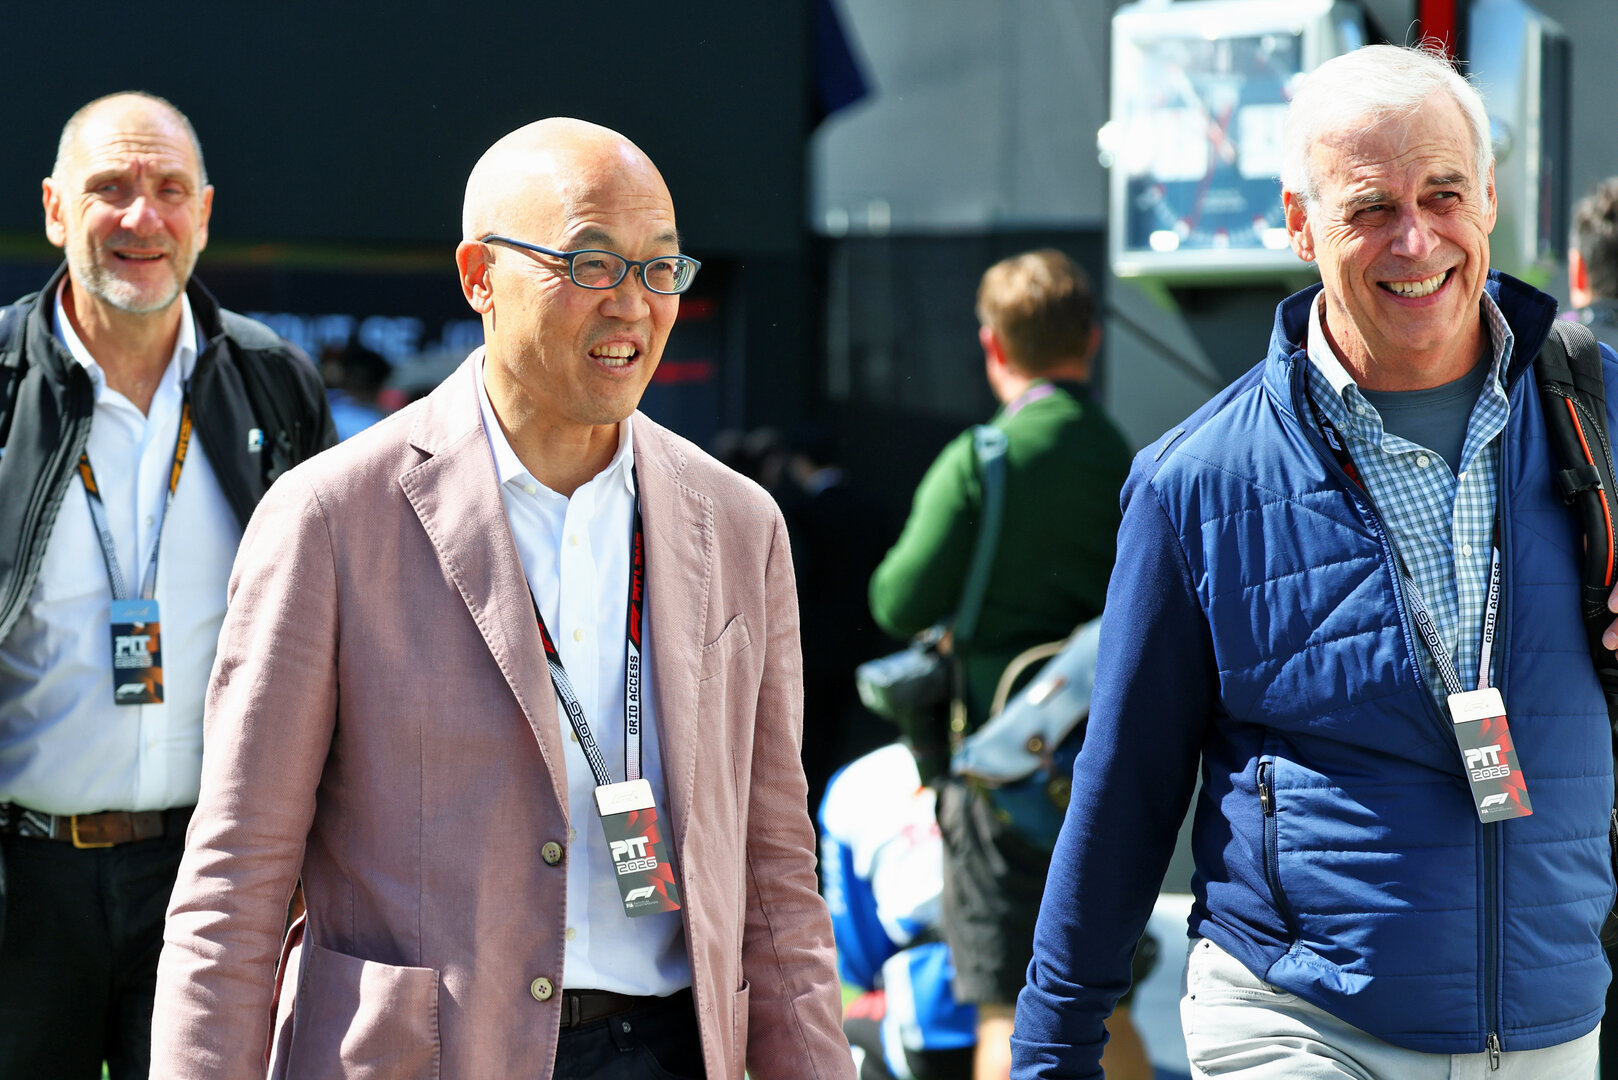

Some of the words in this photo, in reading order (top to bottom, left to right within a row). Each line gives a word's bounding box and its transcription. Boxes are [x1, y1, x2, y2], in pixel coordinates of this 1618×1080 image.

[1489, 562, 1501, 610] ACCESS
[630, 602, 641, 646] F1
[1416, 610, 1445, 659] 2026
[1485, 612, 1496, 644] GRID
[628, 655, 639, 702] ACCESS
[569, 701, 596, 749] 2026
[628, 705, 638, 735] GRID
[1463, 744, 1502, 769] PIT
[1470, 764, 1511, 782] 2026
[1480, 792, 1509, 808] F1
[609, 835, 649, 862] PIT
[615, 856, 658, 875] 2026
[625, 885, 656, 902] F1
